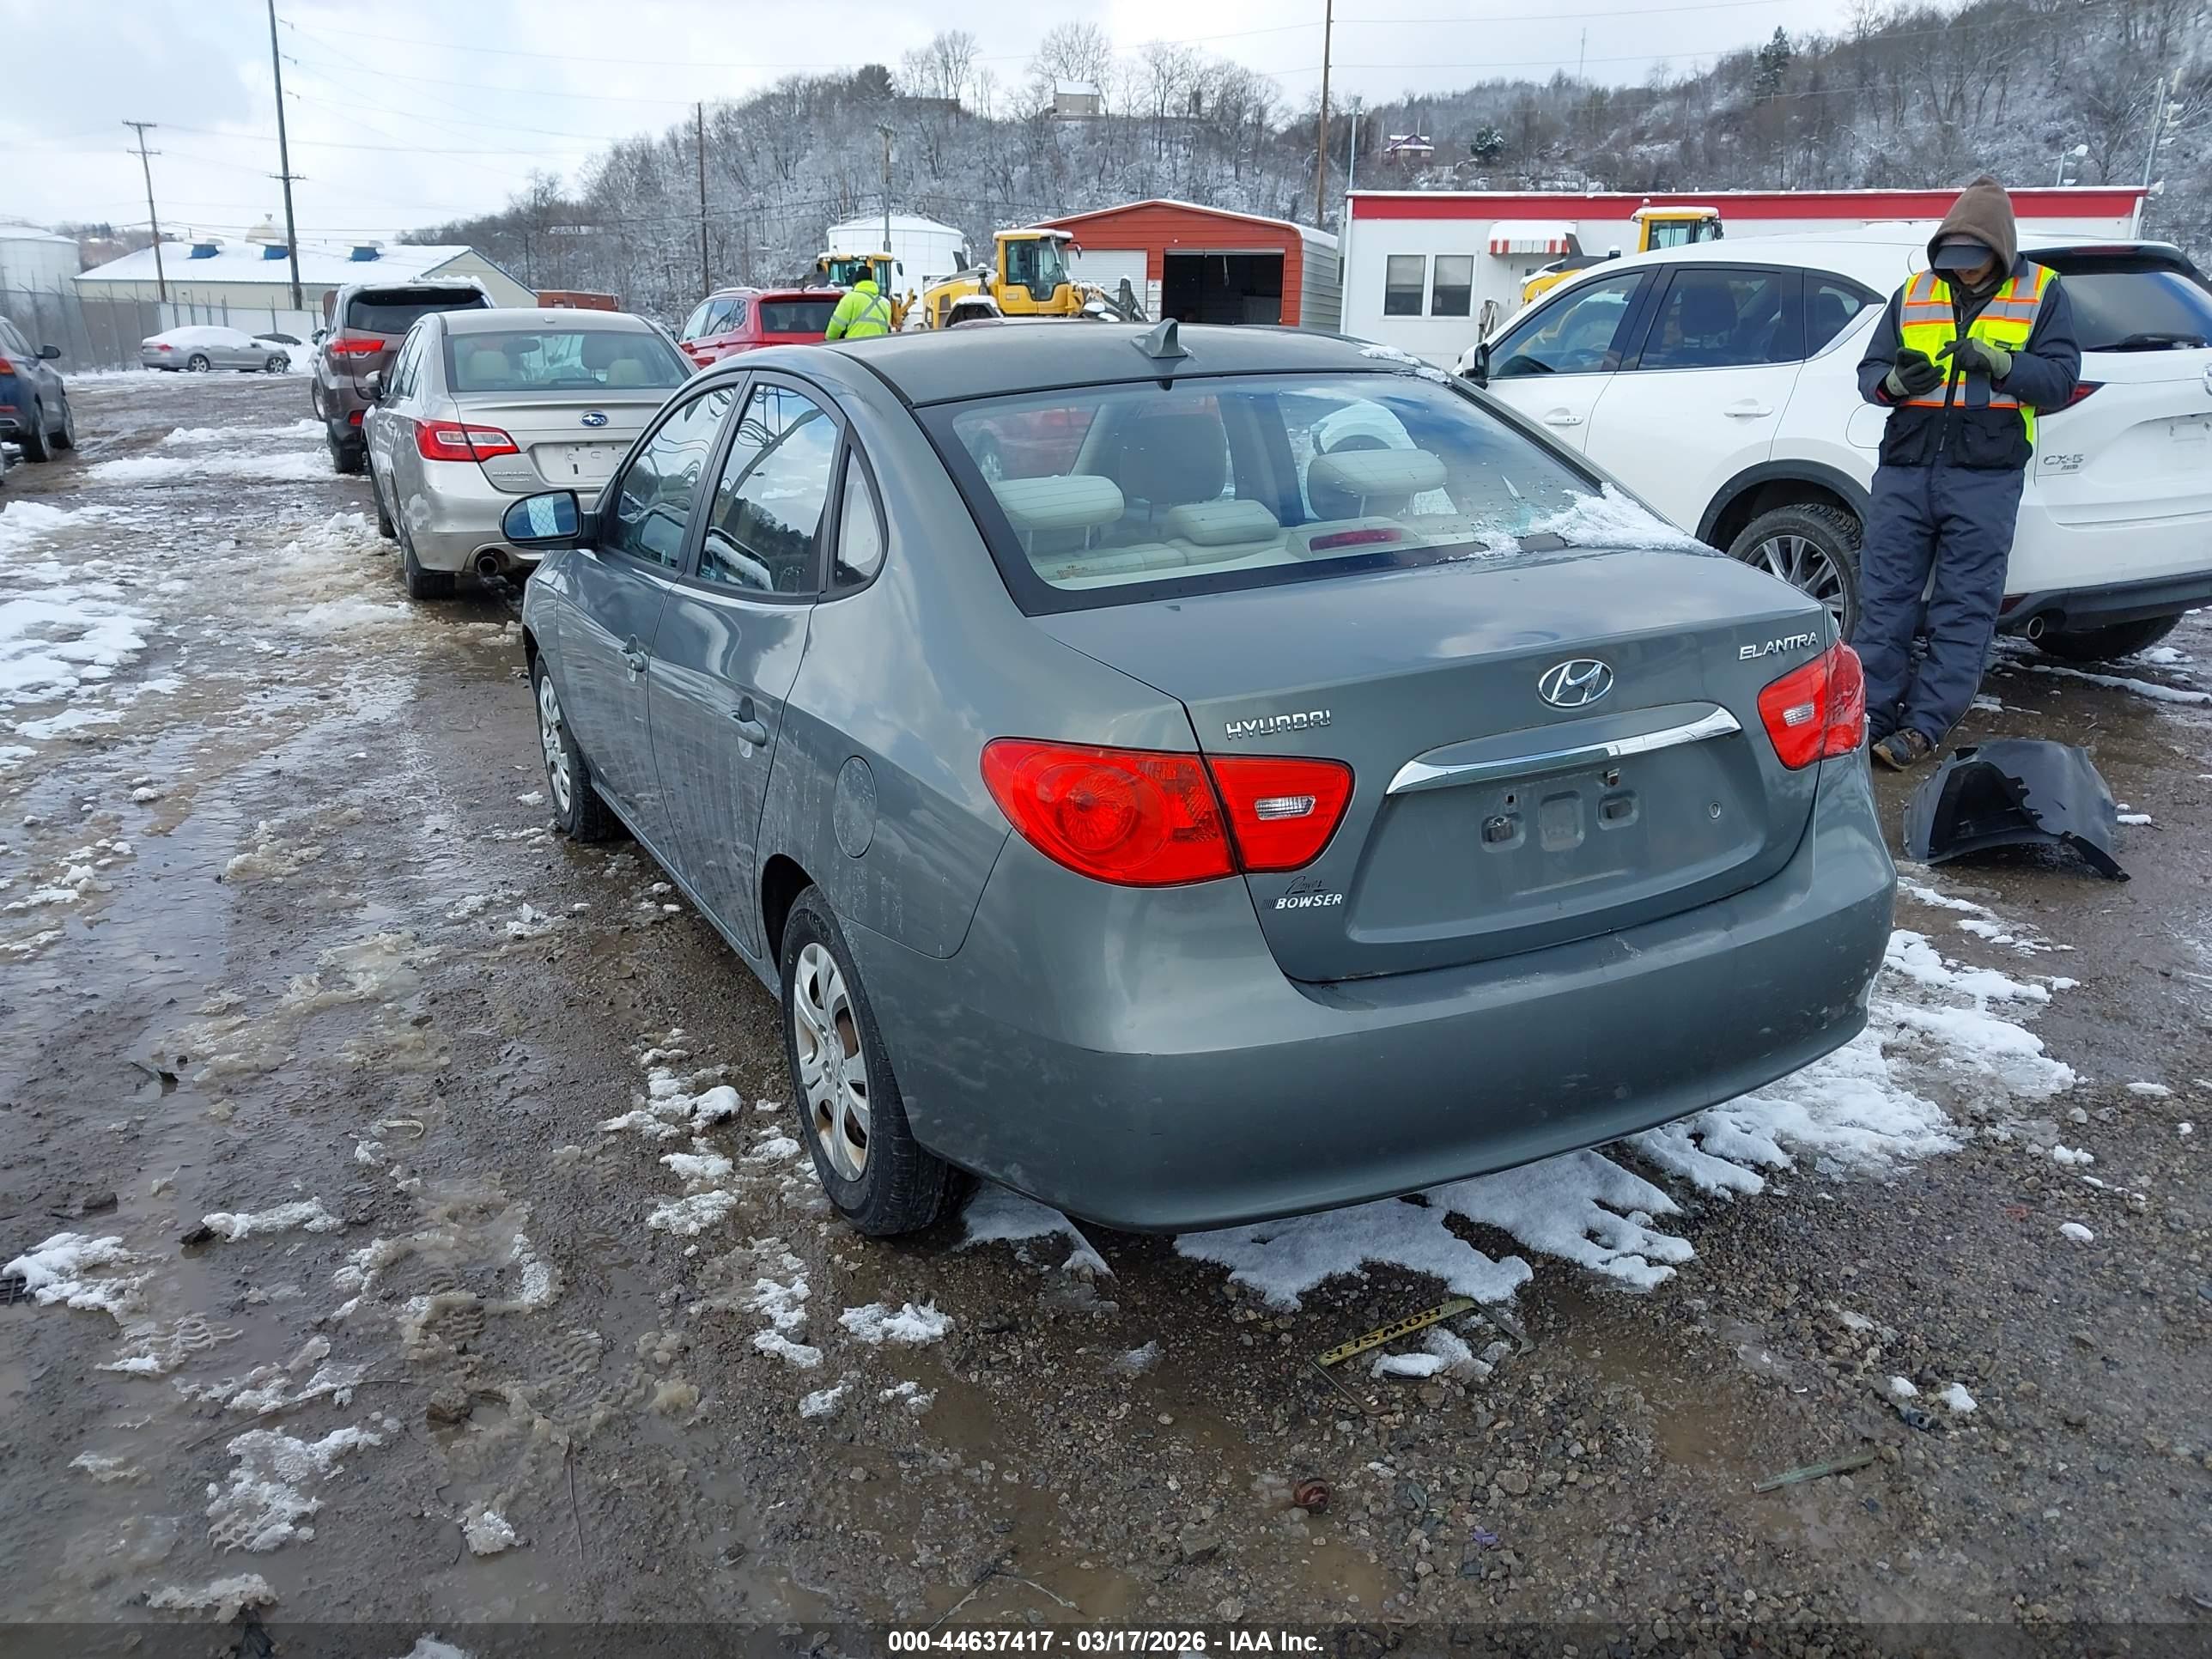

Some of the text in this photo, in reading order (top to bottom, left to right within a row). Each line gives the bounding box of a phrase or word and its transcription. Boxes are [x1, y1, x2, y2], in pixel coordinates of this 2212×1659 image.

[2043, 453, 2084, 465] CX-5
[1738, 631, 1819, 660] ELANTRA
[1224, 709, 1332, 739] HYUNDAI
[1274, 893, 1344, 910] BOWSER
